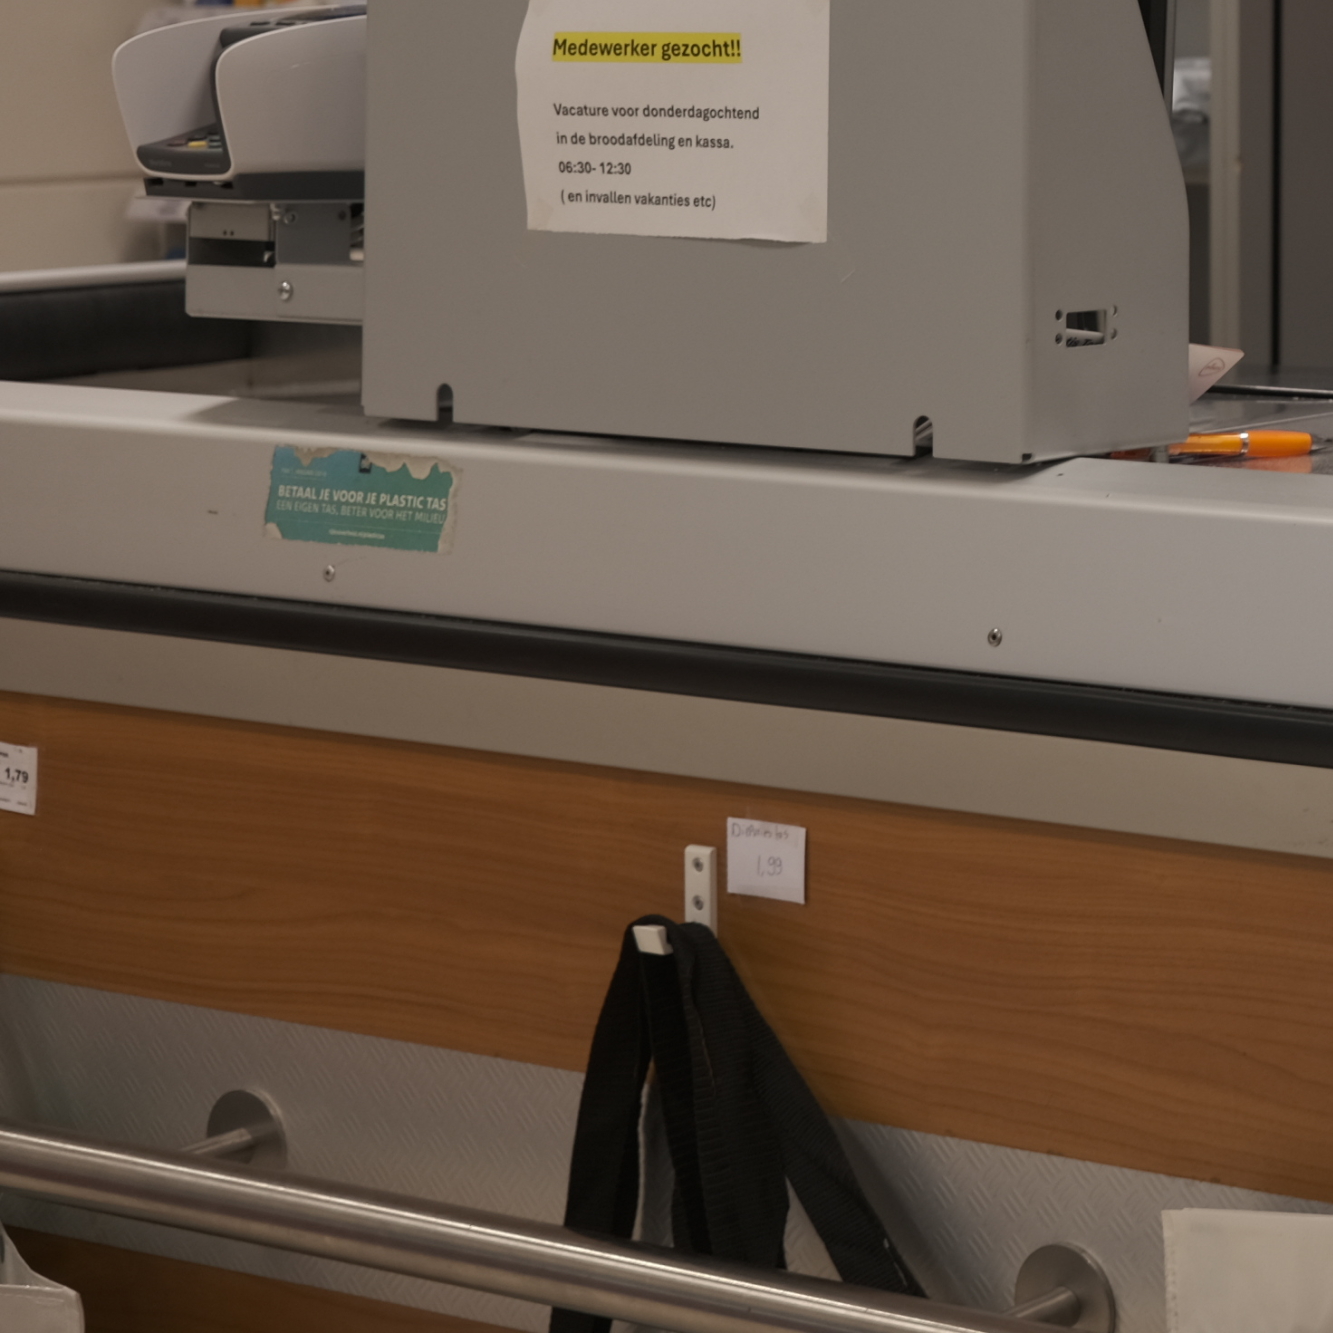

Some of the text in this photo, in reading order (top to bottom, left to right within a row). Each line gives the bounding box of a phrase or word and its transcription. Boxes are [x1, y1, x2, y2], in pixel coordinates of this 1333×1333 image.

[553, 38, 741, 61] Medewerker gezocht!!
[554, 103, 760, 121] Vacature voor donderdagochtend
[556, 131, 734, 150] in de broodafdeling en kassa.
[558, 161, 632, 175] 06:30- 12:30
[567, 191, 583, 202] en
[585, 189, 632, 204] invallen
[634, 191, 690, 207] vakanties
[692, 194, 716, 211] etc)
[278, 485, 447, 512] BETAAL JE VOOR JE PLASTIC TAS
[276, 499, 293, 511] EEN
[293, 500, 319, 513] EIGEN
[321, 502, 339, 516] TAS,
[340, 504, 368, 517] BETER
[369, 506, 395, 520] VOOR
[395, 509, 413, 521] HET
[5, 767, 29, 783] 1,79
[756, 854, 784, 878] 1,99
